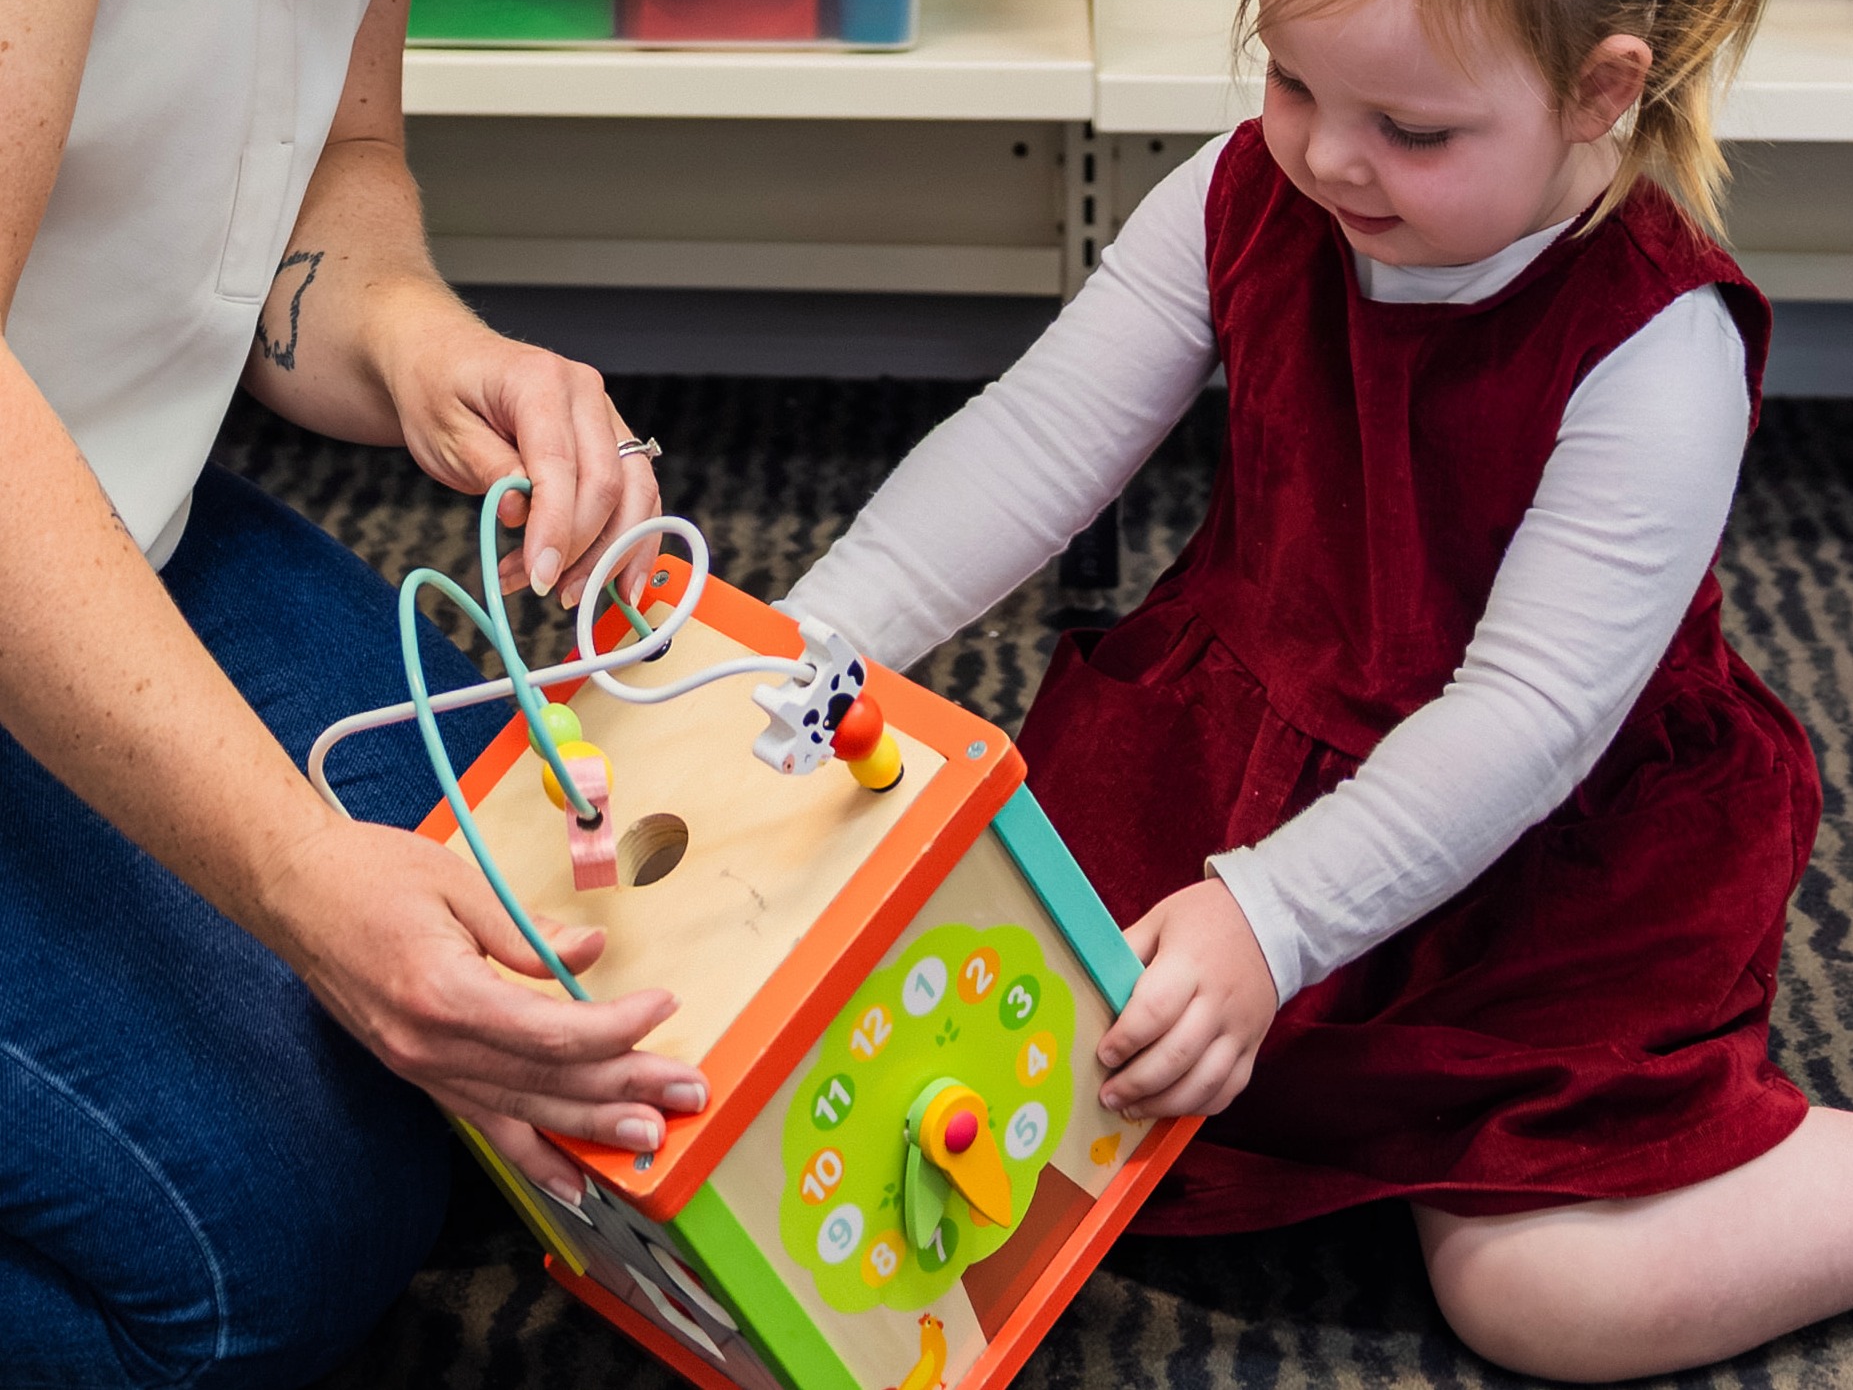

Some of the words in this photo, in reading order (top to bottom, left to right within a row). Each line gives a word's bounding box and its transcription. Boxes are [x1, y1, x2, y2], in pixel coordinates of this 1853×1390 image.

[915, 972, 935, 998] 1
[965, 956, 994, 995] 2
[1007, 984, 1033, 1019] 3
[850, 1006, 892, 1057] 12
[1028, 1041, 1048, 1078] 4
[815, 1078, 851, 1123] 11
[1014, 1112, 1038, 1147] 5
[801, 1150, 843, 1200] 10
[827, 1217, 853, 1250] 9
[871, 1242, 897, 1277] 8
